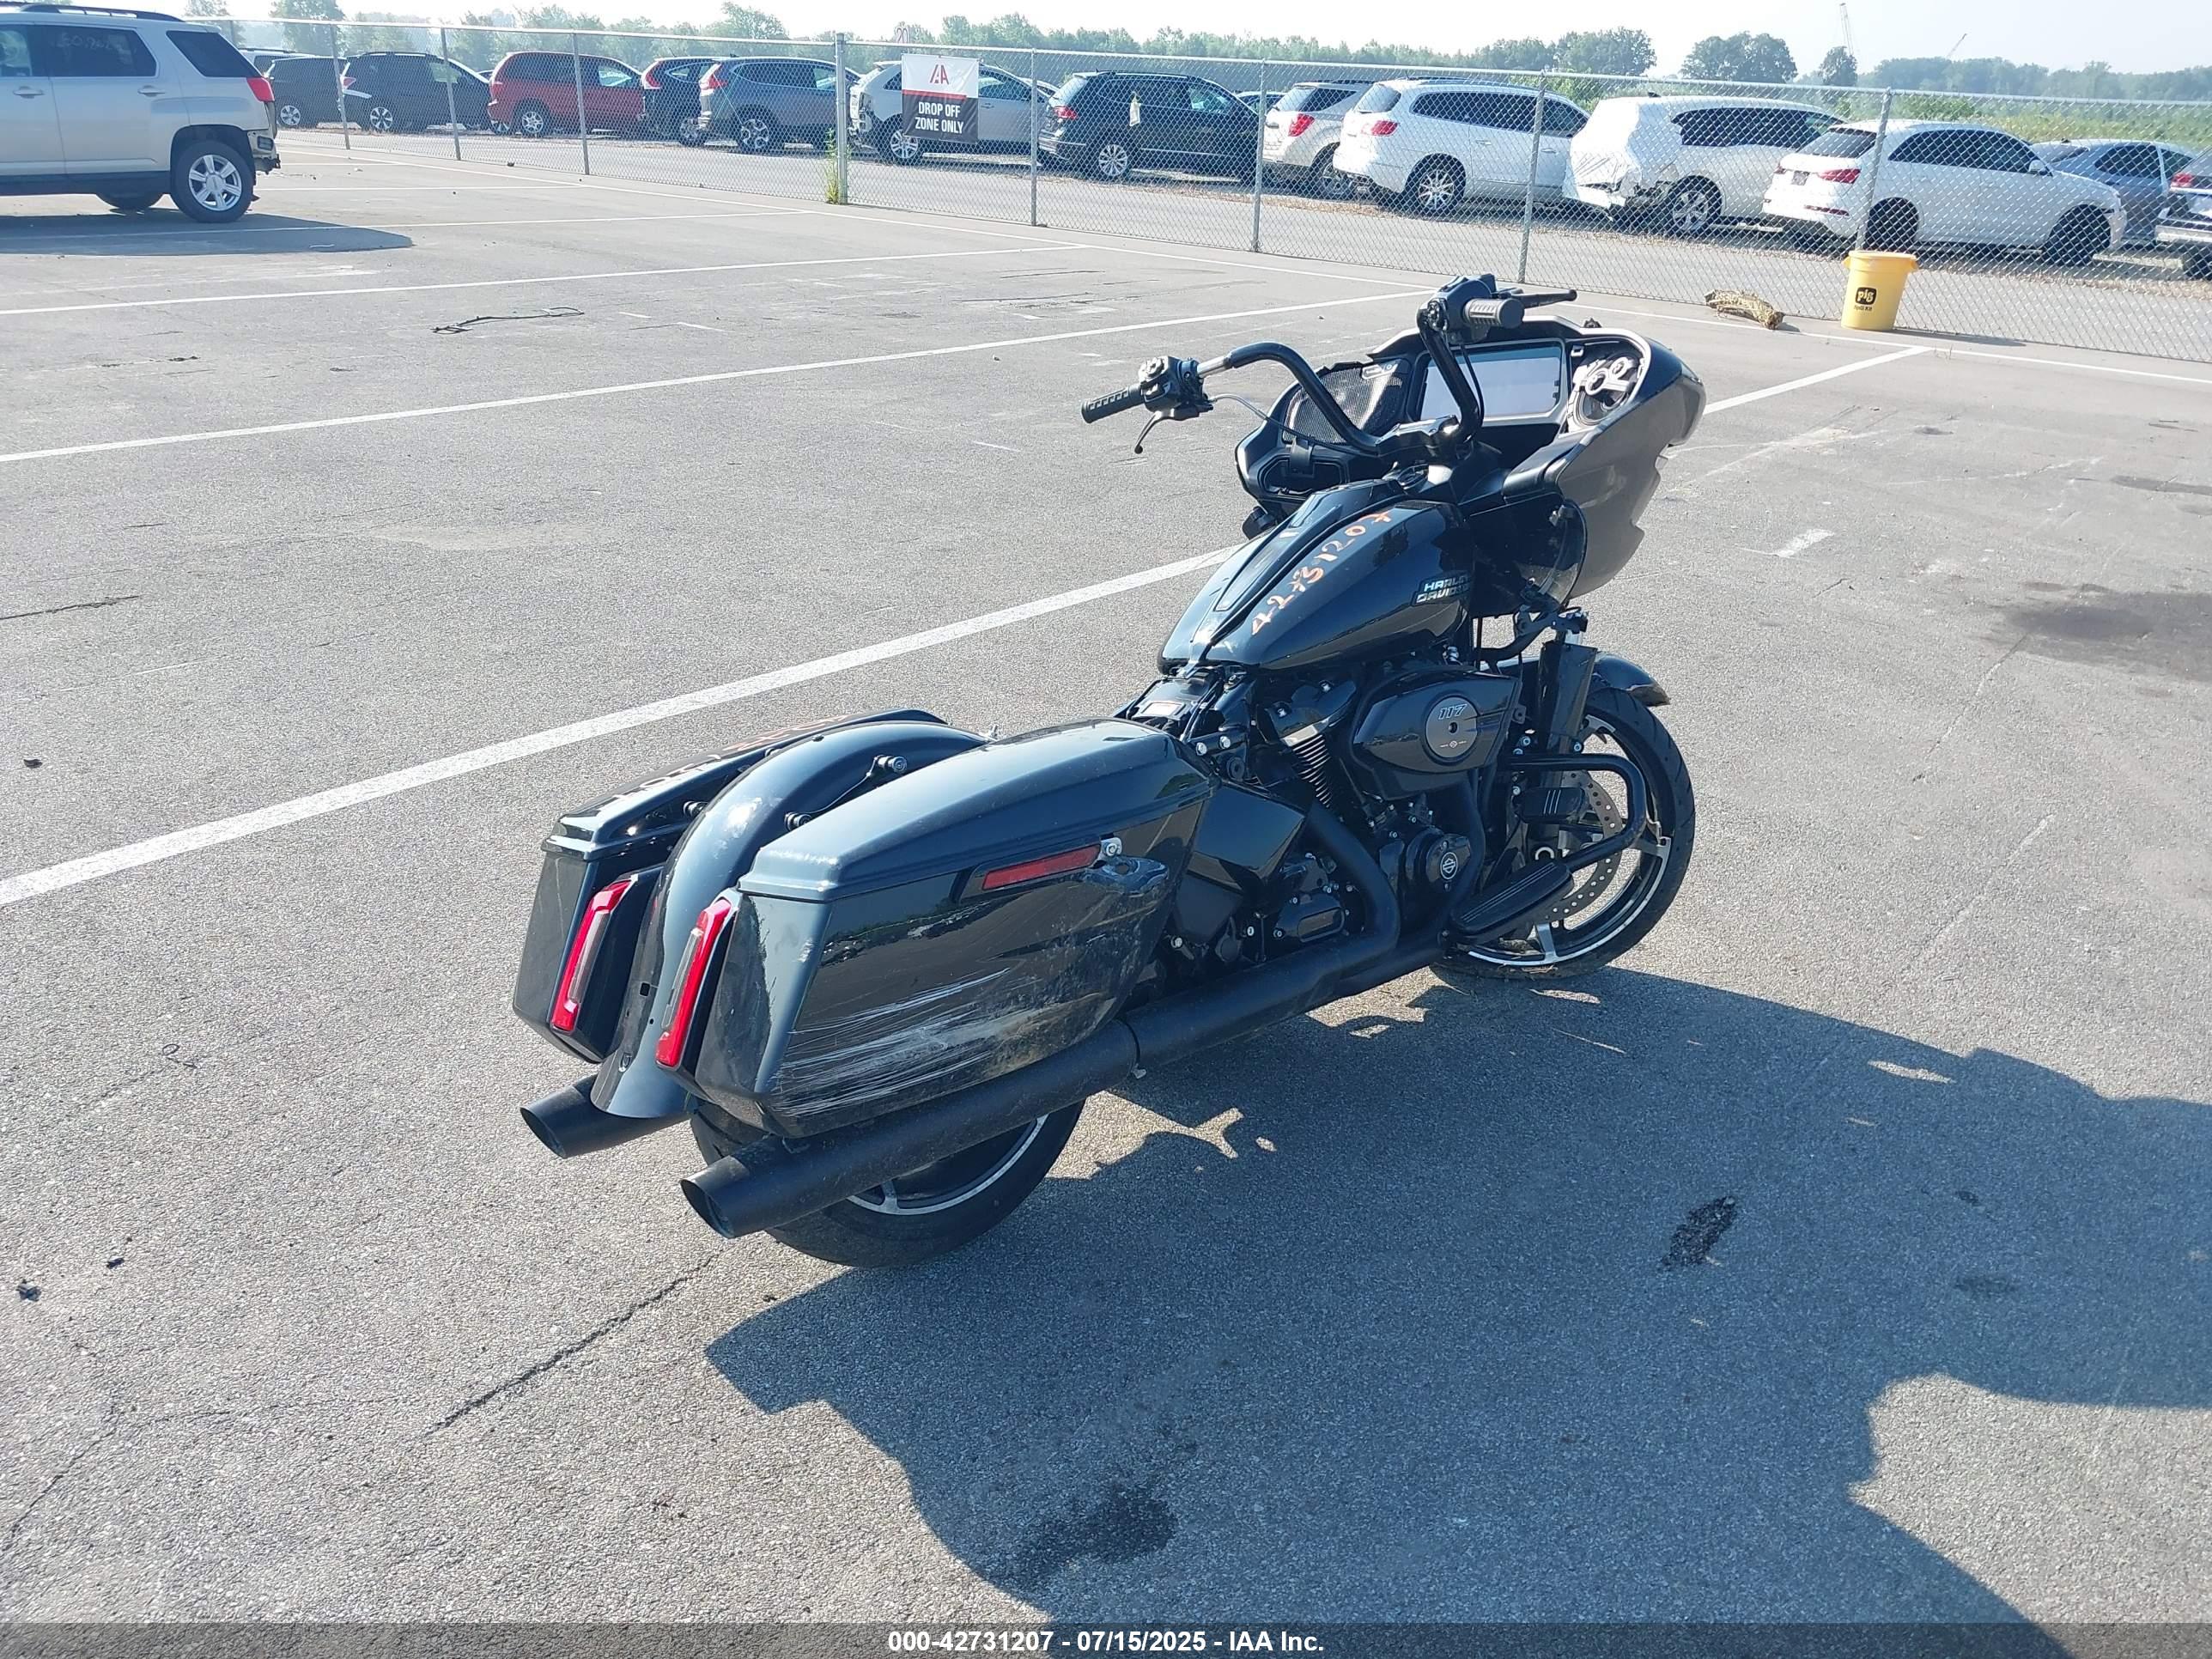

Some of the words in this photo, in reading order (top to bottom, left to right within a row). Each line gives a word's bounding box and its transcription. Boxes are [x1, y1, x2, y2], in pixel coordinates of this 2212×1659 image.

[918, 101, 943, 117] DROP
[945, 103, 961, 118] OFF
[915, 117, 939, 131] ZONE
[941, 119, 964, 134] ONLY
[1423, 575, 1468, 592] HARL
[1415, 584, 1468, 604] DAVID
[1437, 703, 1468, 720] 117
